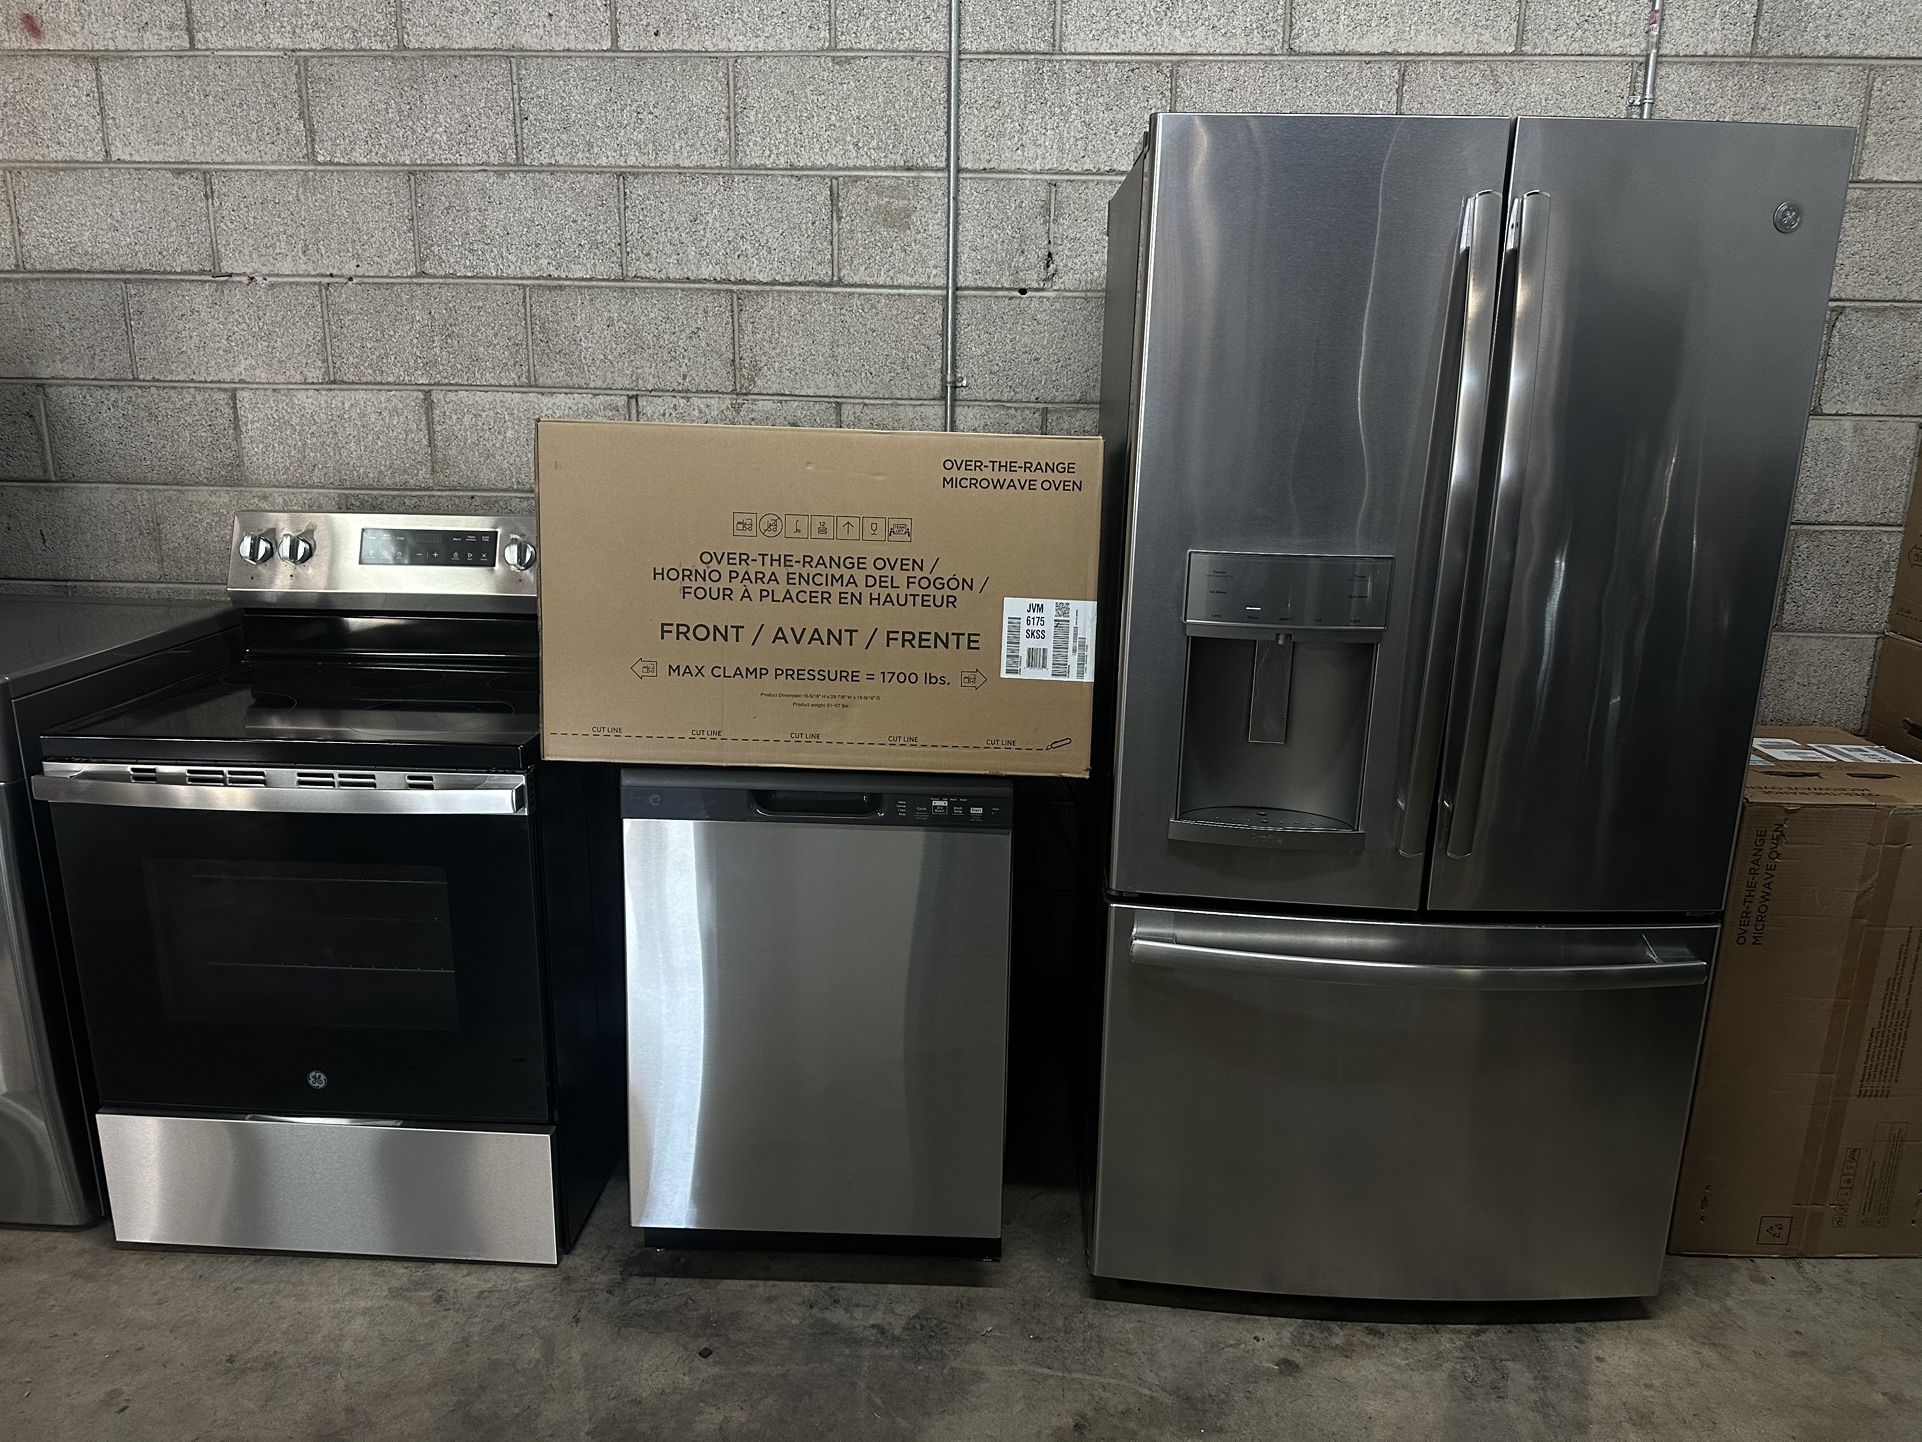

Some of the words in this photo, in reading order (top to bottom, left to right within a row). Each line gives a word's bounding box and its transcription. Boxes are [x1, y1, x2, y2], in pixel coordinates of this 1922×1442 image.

[942, 458, 1076, 474] OVER-THE-RANGE
[942, 476, 1038, 490] MICROWAVE
[1040, 479, 1082, 492] OVEN
[700, 551, 868, 570] OVER-THE-RANGE
[873, 557, 924, 572] OVEN
[929, 557, 940, 574] /
[652, 567, 722, 583] HORNO
[728, 570, 780, 584] PARA
[786, 572, 858, 588] ENCIMA
[864, 574, 900, 589] DEL
[906, 574, 974, 591] FOGÓN
[978, 576, 990, 594] /
[682, 586, 734, 601] FOUR
[740, 585, 753, 602] À
[759, 588, 832, 604] PLACER
[838, 592, 862, 606] EN
[869, 592, 958, 608] HAUTEUR
[1026, 602, 1044, 614] JVM
[1026, 616, 1045, 626] 6175
[660, 622, 744, 642] FRONT
[750, 624, 765, 646] /
[772, 626, 858, 646] AVANT
[864, 628, 878, 650] /
[886, 630, 981, 650] FRENTE
[1025, 628, 1046, 640] SKSS
[668, 664, 705, 678] MAX
[711, 666, 769, 680] CLAMP
[774, 668, 860, 682] PRESSURE
[880, 672, 919, 684] 1700
[924, 672, 951, 686] lbs.
[1736, 830, 1767, 946] OVER-THE-RANGE
[1752, 864, 1776, 946] MICROWAVE
[1768, 824, 1784, 860] OVEN
